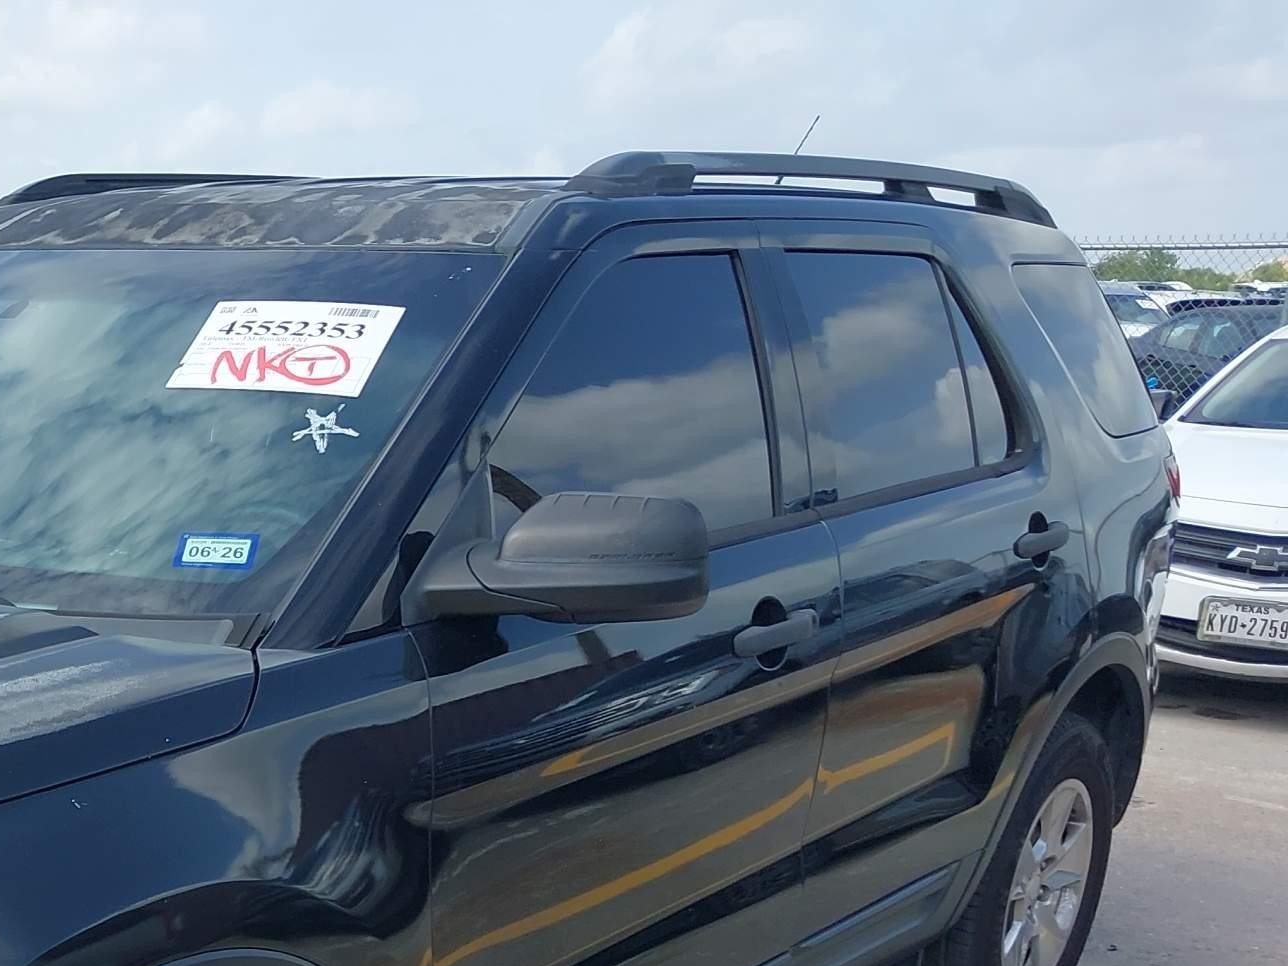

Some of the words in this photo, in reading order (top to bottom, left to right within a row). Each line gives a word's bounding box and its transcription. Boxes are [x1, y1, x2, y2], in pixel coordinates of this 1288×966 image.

[218, 320, 366, 340] 45552353
[189, 546, 211, 558] 06
[221, 546, 244, 559] 26
[1235, 604, 1270, 615] TEXAS
